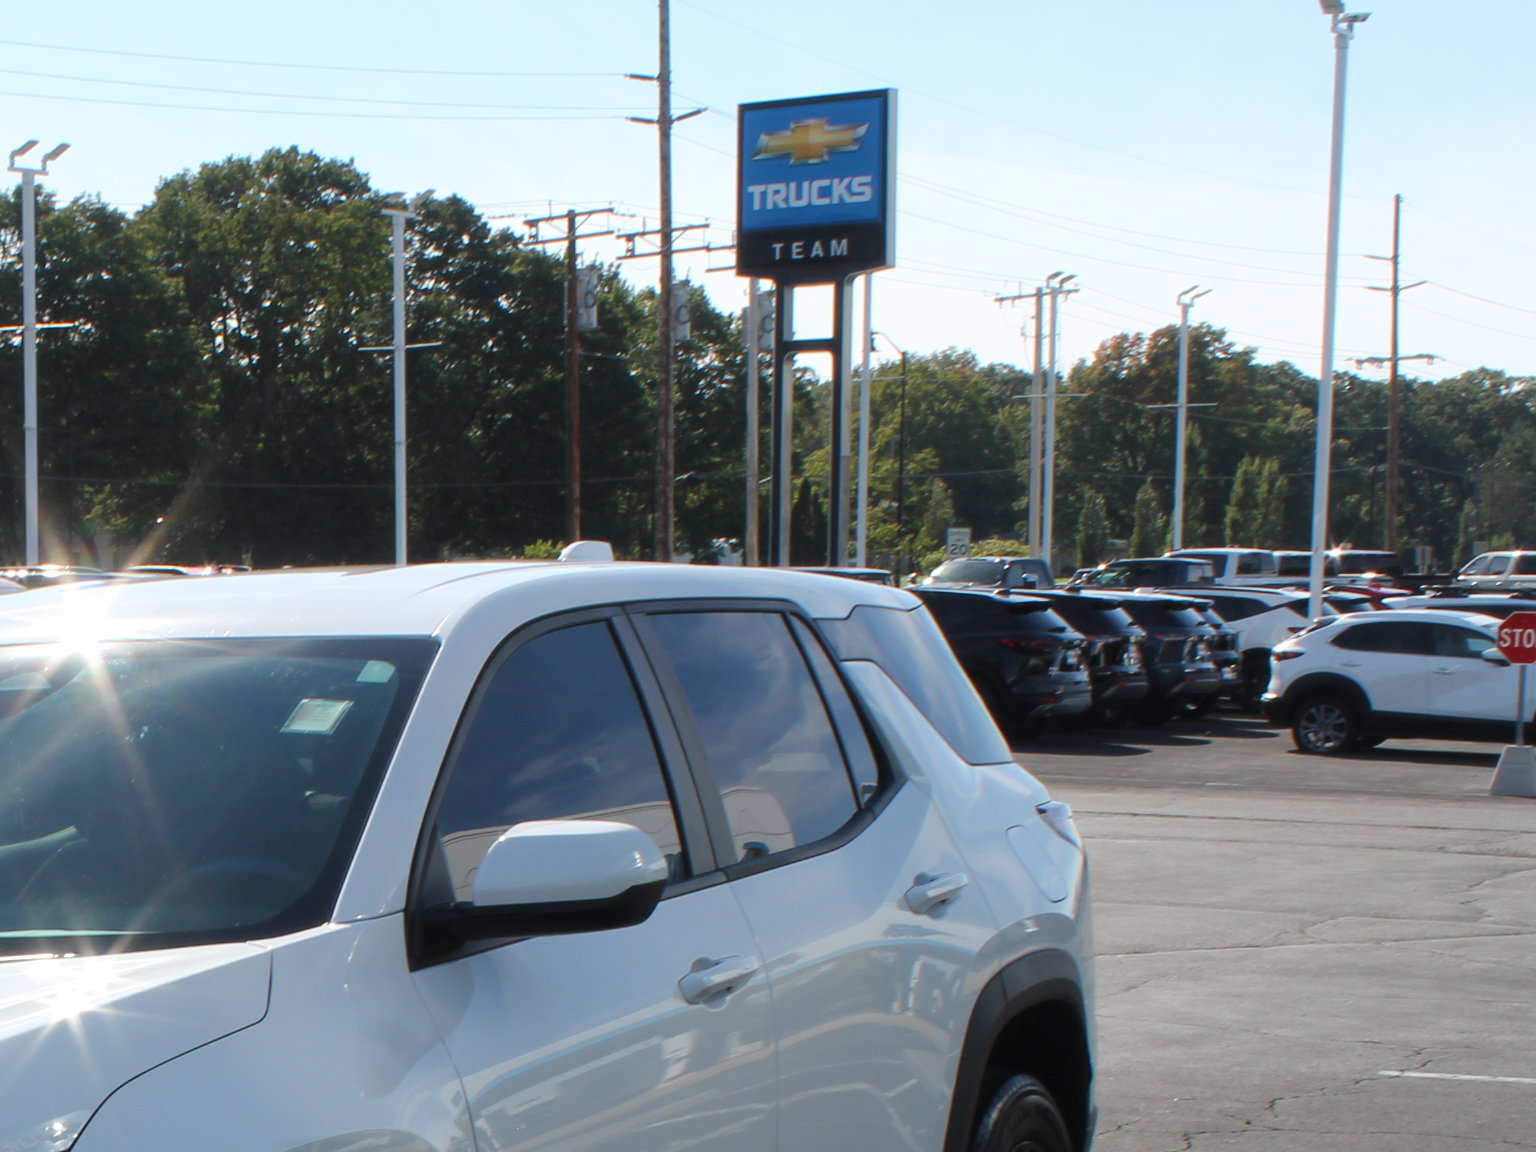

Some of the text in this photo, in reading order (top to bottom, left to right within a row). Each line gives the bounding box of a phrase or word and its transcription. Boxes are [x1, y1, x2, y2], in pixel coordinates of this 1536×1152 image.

[747, 175, 872, 211] TRUCKS
[771, 238, 848, 260] TEAM
[950, 543, 968, 555] 20
[1499, 628, 1536, 648] STO
